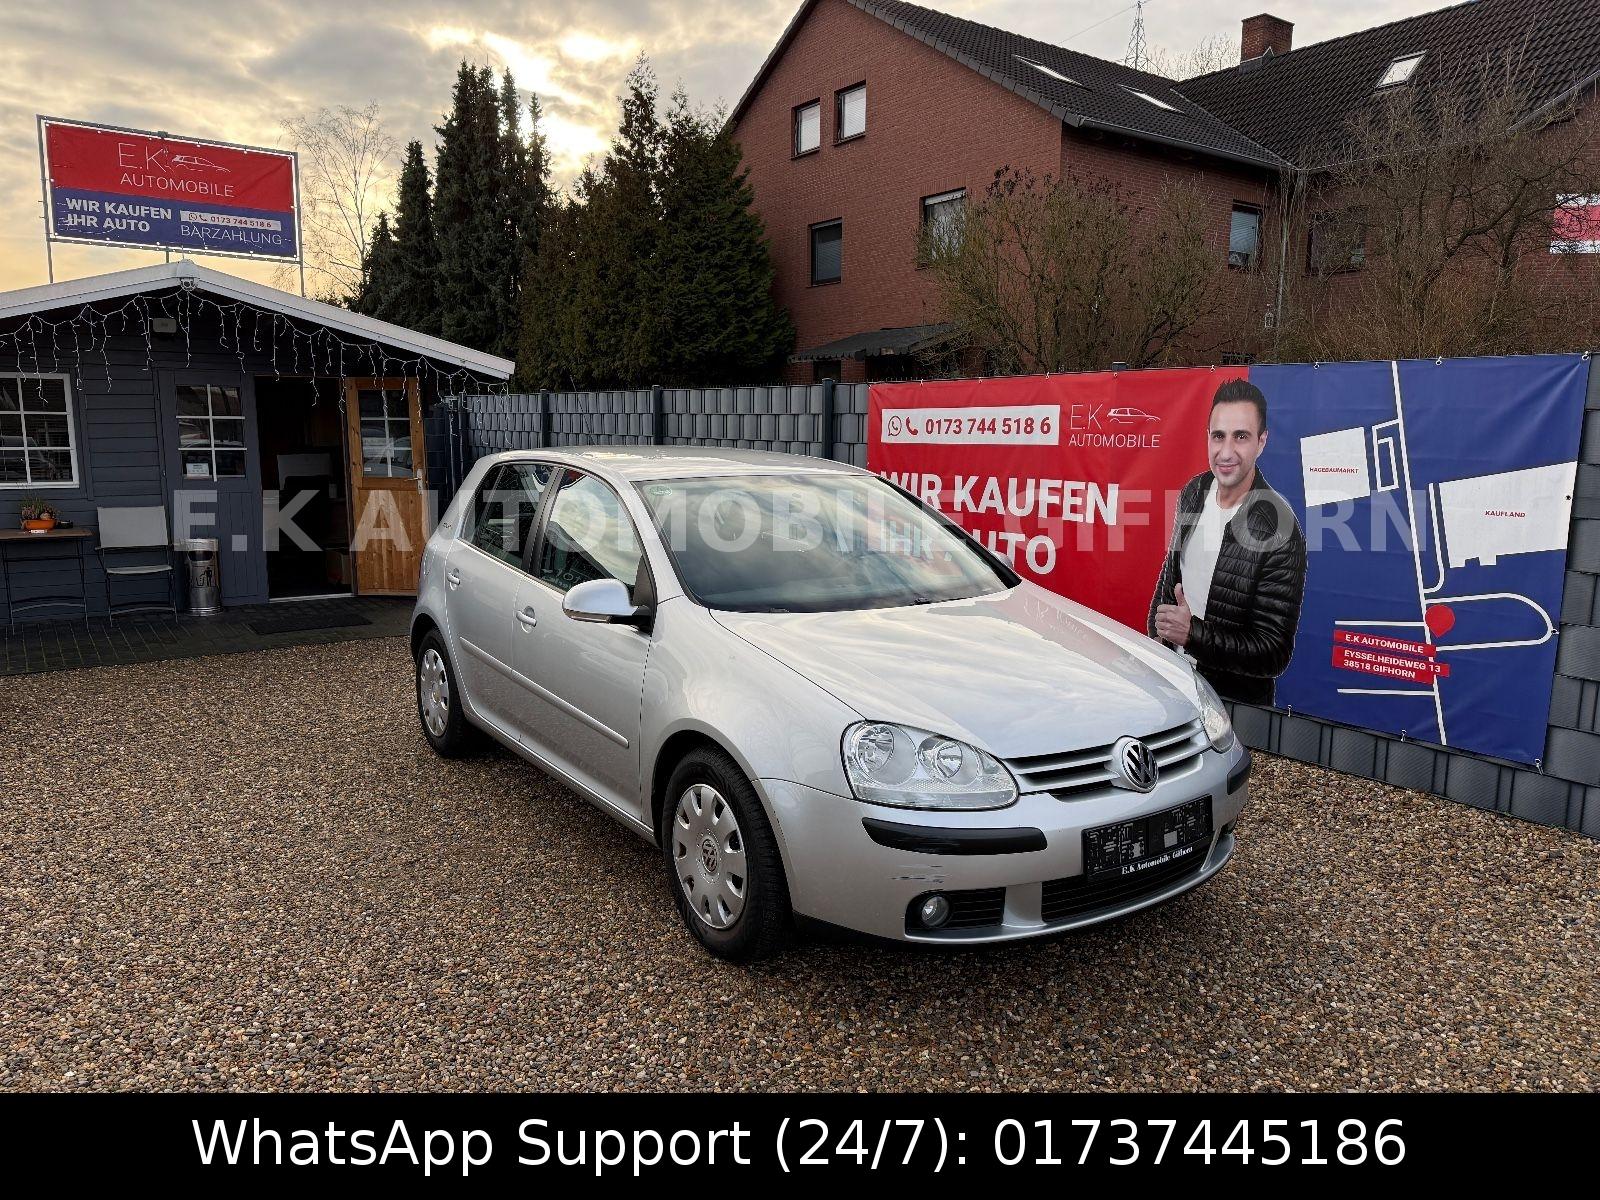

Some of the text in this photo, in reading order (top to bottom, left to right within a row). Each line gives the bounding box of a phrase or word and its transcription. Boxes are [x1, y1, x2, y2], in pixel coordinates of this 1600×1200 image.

[118, 142, 167, 173] E.K
[120, 172, 235, 198] AUTOMOBILE
[65, 197, 172, 220] WIR KAUFEN
[66, 213, 151, 232] IHR AUTO
[210, 216, 231, 224] 0173
[233, 218, 248, 226] 744
[180, 224, 282, 245] BARZAHLUNG
[925, 416, 1051, 435] 0173 744 518 6
[1069, 403, 1104, 430] E.K
[1069, 433, 1161, 448] AUTOMOBILE
[953, 475, 1119, 526] KAUFEN
[1485, 510, 1526, 518] KAUFLAND
[944, 529, 1057, 575] TO
[1345, 633, 1424, 654] E.K AUTOMOBILE
[1343, 659, 1416, 679] 38518 GIFHORN
[1344, 649, 1441, 673] EYSSELHEIDEWEG 13
